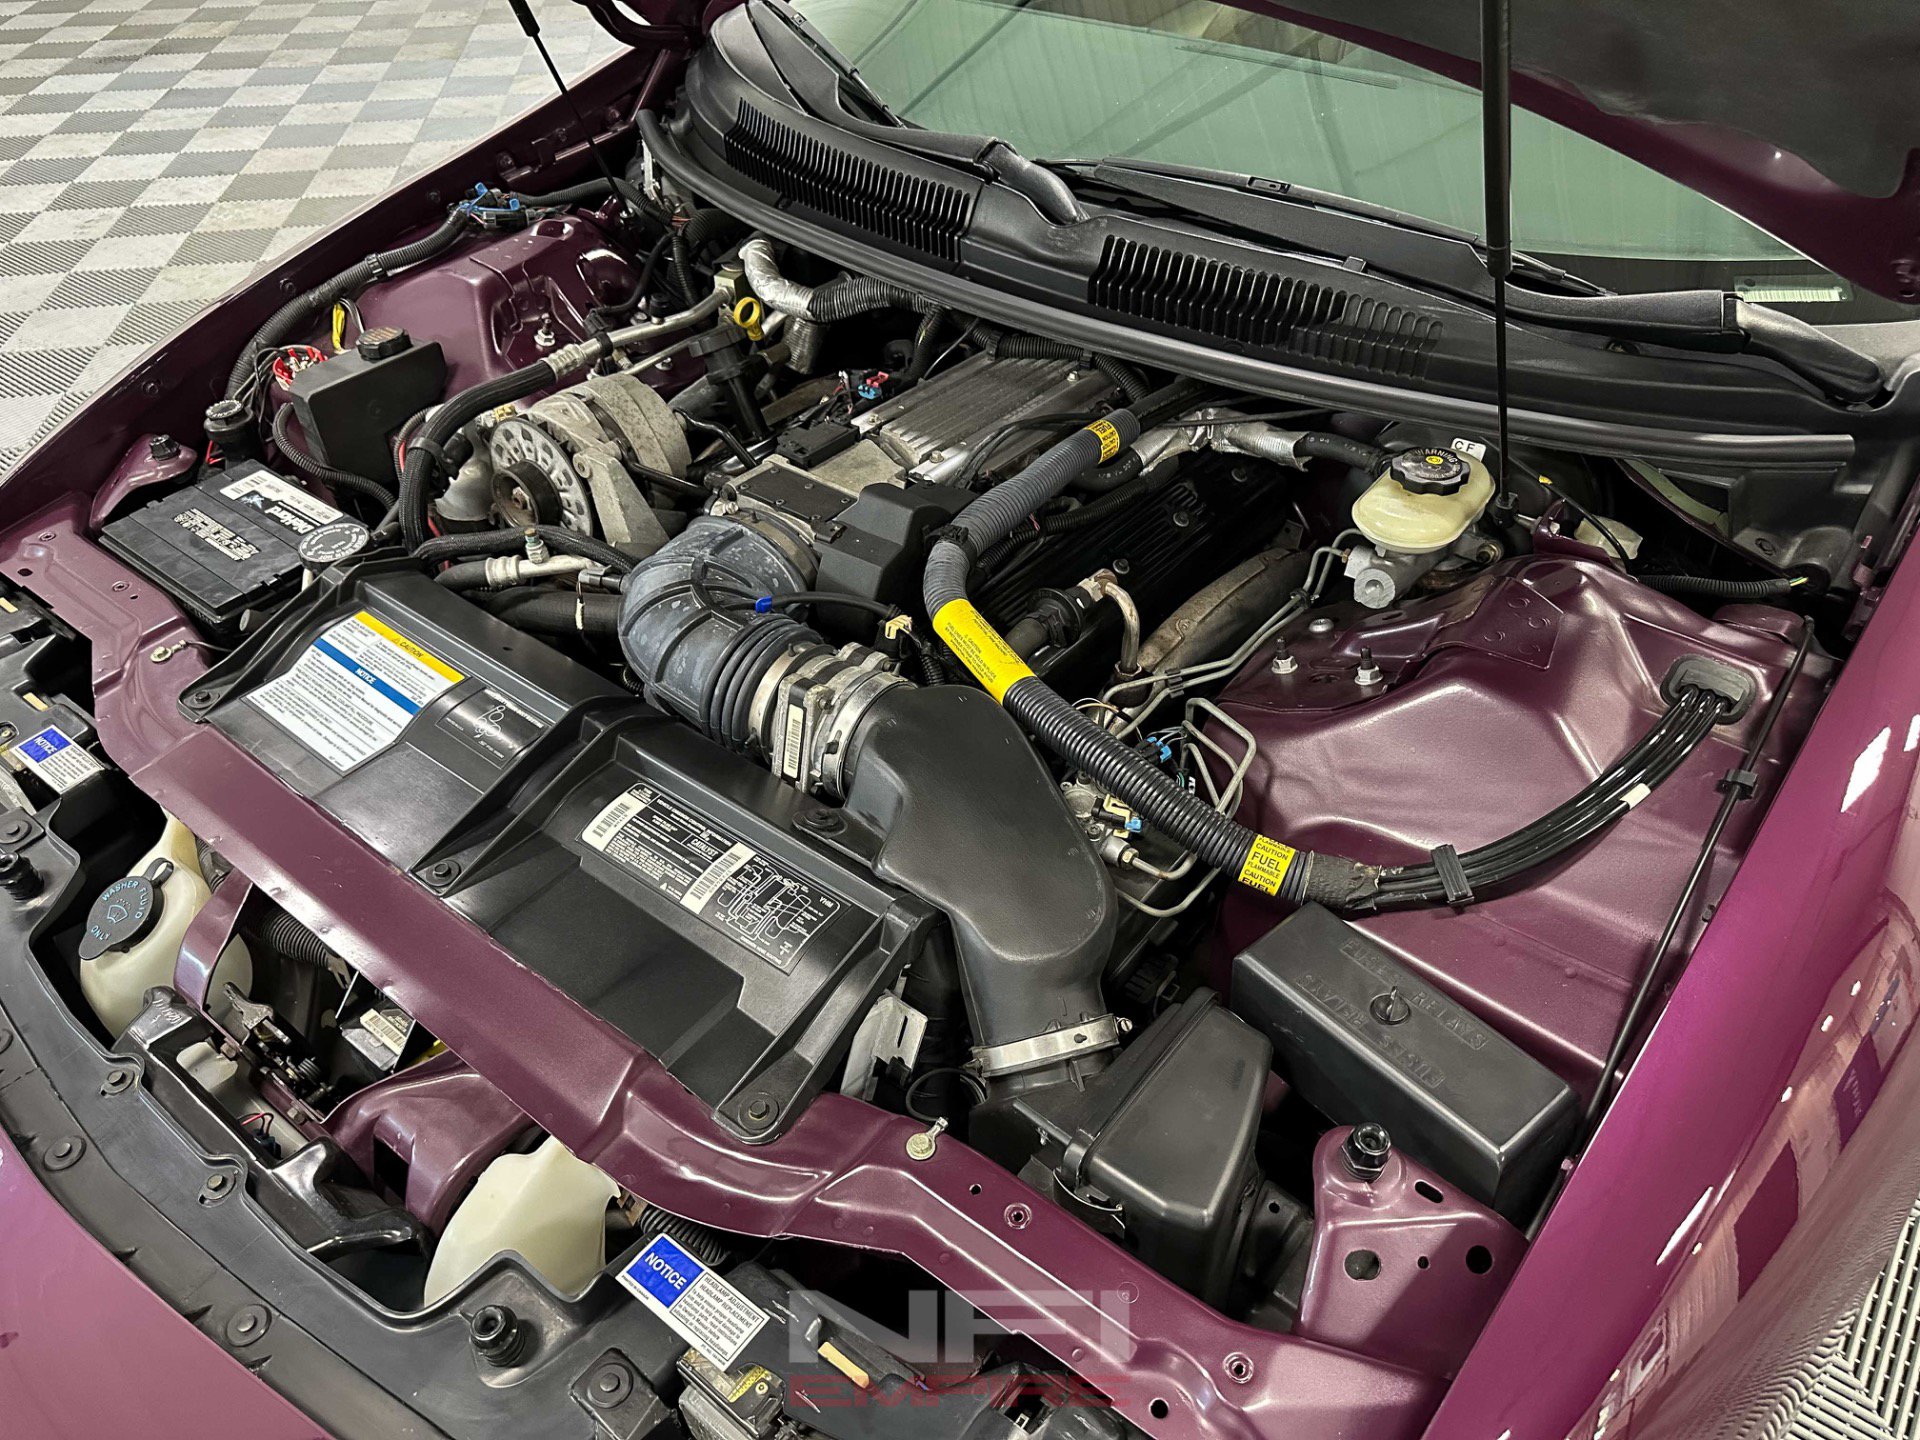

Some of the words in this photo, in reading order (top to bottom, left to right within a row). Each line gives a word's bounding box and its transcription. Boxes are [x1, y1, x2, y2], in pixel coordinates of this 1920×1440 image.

[265, 505, 312, 536] DieHard
[400, 641, 422, 657] CAUTION
[355, 668, 375, 683] NOTICE
[34, 736, 56, 753] NOTICE
[691, 838, 717, 856] CATALYST
[1256, 843, 1287, 859] CAUTION
[1248, 861, 1279, 877] FLAMMABLE
[1252, 852, 1281, 871] FUEL
[1242, 877, 1268, 892] FUEL
[1245, 870, 1275, 886] CAUTION
[102, 880, 139, 901] WASHER
[134, 887, 148, 919] FLUID
[818, 896, 833, 908] YHM
[91, 925, 110, 940] ONLY
[1410, 990, 1486, 1048] RELAYS
[645, 1252, 686, 1289] NOTICE
[700, 1284, 722, 1303] HEADLAMP
[722, 1302, 751, 1327] REPLACEMENT
[704, 1277, 729, 1298] HEADLAMP
[728, 1296, 758, 1321] ADJUSTMENT
[683, 1299, 698, 1313] headlamp
[708, 1320, 718, 1329] read
[717, 1327, 736, 1345] instructions
[696, 1291, 705, 1301] help
[703, 1299, 715, 1310] ensure
[714, 1307, 727, 1320] proper
[727, 1317, 743, 1333] headlamp
[704, 1307, 713, 1317] help
[711, 1313, 722, 1324] avoid
[721, 1321, 736, 1336] damage
[674, 1308, 688, 1322] adjusting
[693, 1325, 708, 1339] replacing
[695, 1317, 709, 1330] Manual
[707, 1328, 720, 1340] before
